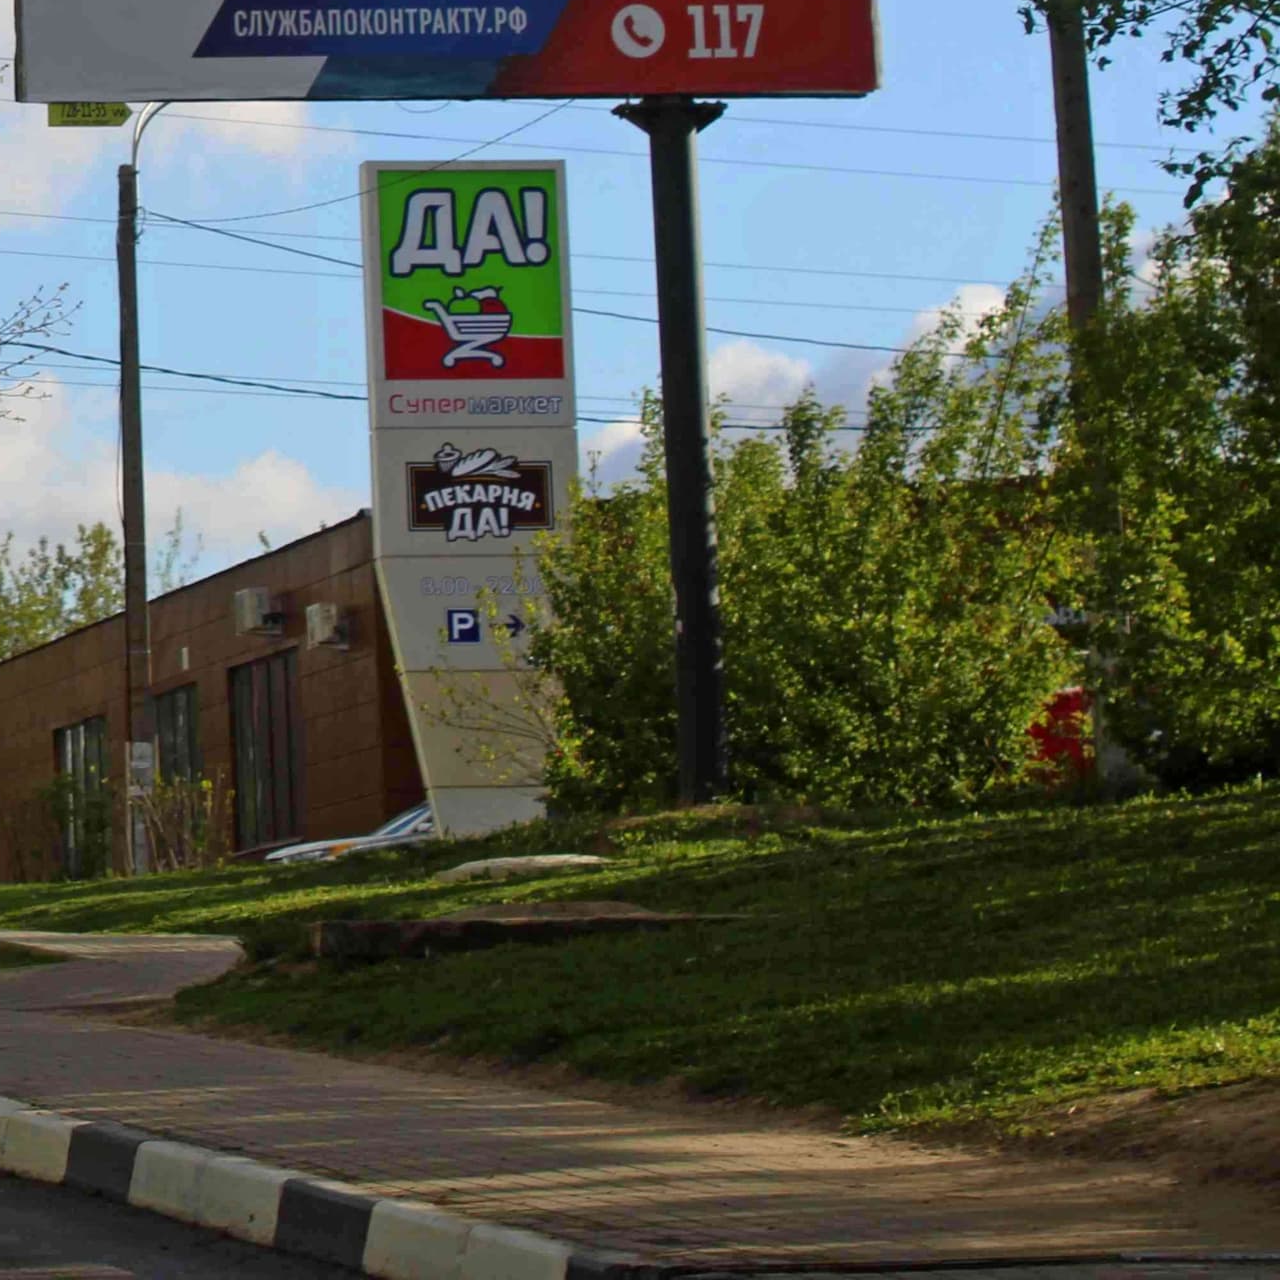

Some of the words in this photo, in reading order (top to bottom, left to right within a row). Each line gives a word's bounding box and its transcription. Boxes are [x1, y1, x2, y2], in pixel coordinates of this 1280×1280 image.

[233, 4, 529, 39] СЛУЖБАПОКОНТРАКТУ.РФ
[686, 3, 764, 60] 117
[390, 187, 550, 277] ДА!
[389, 393, 563, 415] Супермаркет
[424, 484, 536, 512] ПЕКАРНЯ
[448, 507, 511, 540] ДА!
